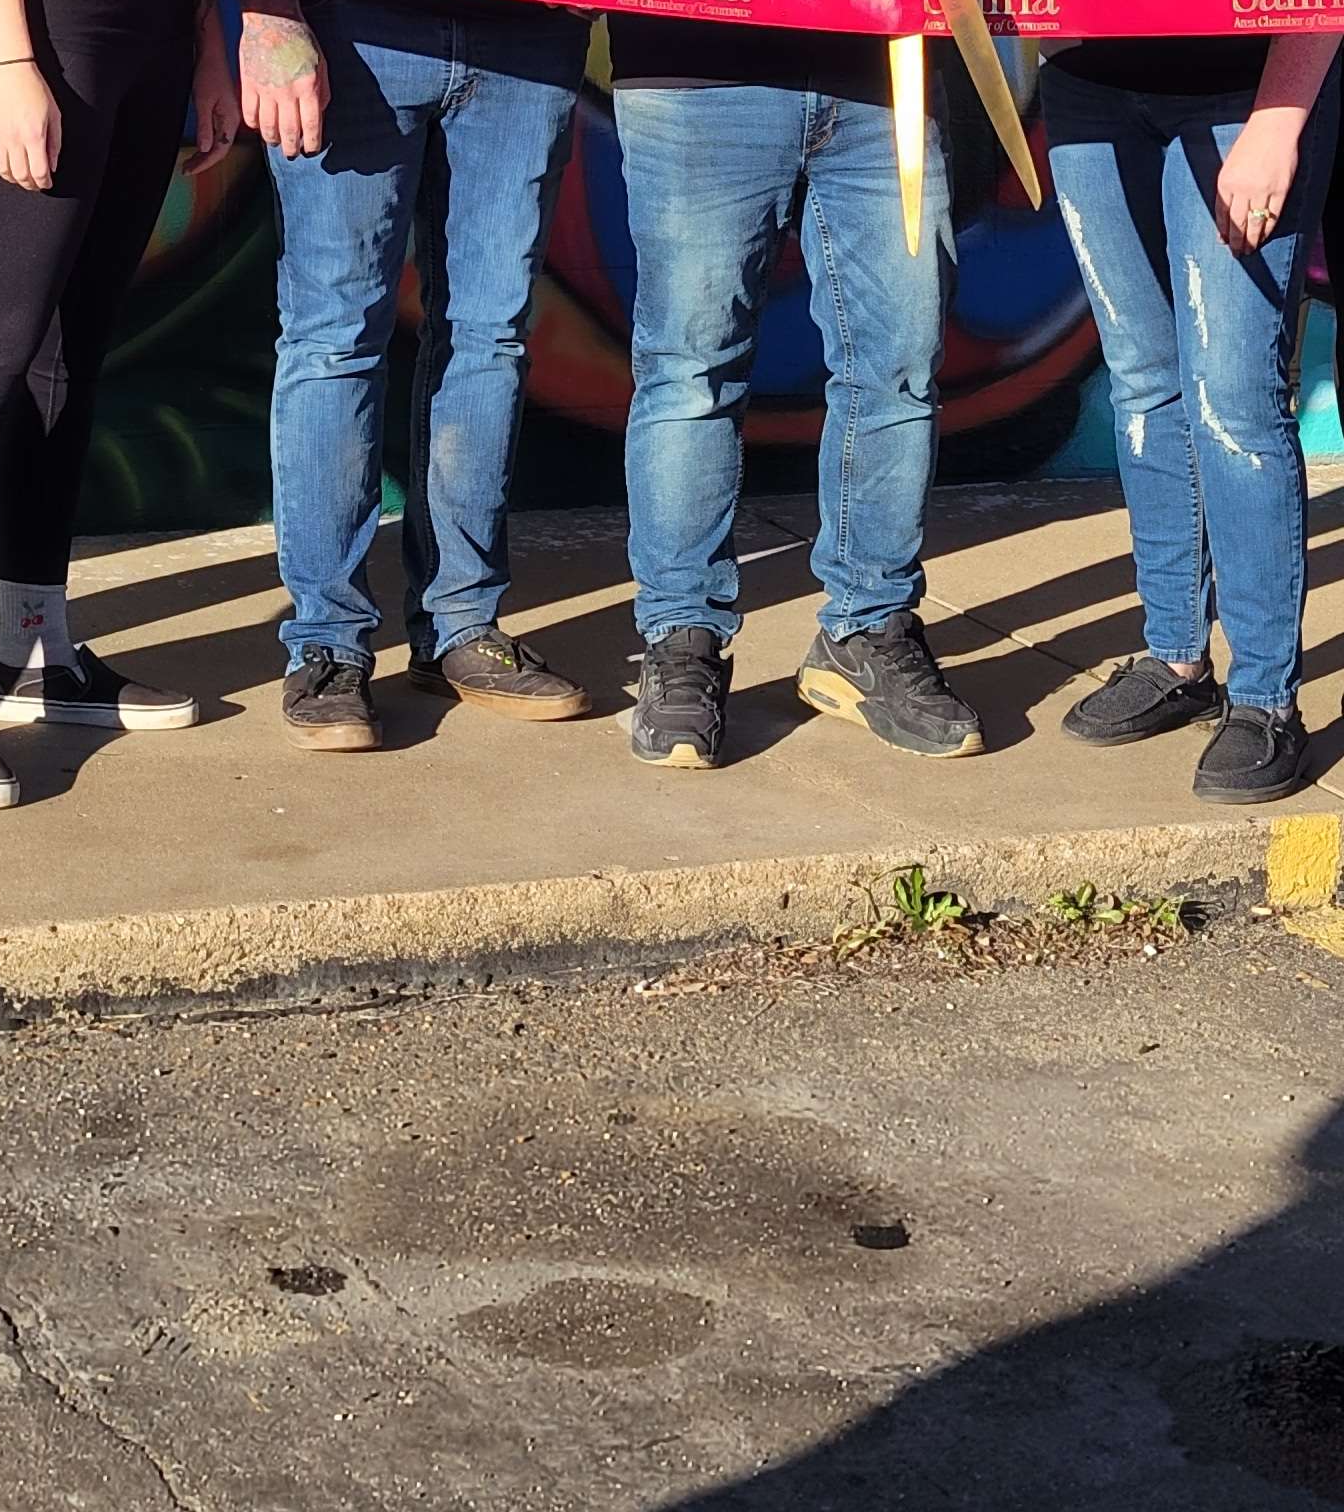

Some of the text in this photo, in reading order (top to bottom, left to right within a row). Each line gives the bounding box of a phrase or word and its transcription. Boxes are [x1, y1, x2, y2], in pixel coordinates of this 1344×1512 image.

[685, 1, 699, 15] of
[993, 18, 1007, 32] of
[1007, 20, 1060, 31] Commerce
[1234, 16, 1256, 28] Area
[1257, 14, 1304, 27] Chamber
[1304, 13, 1318, 29] of
